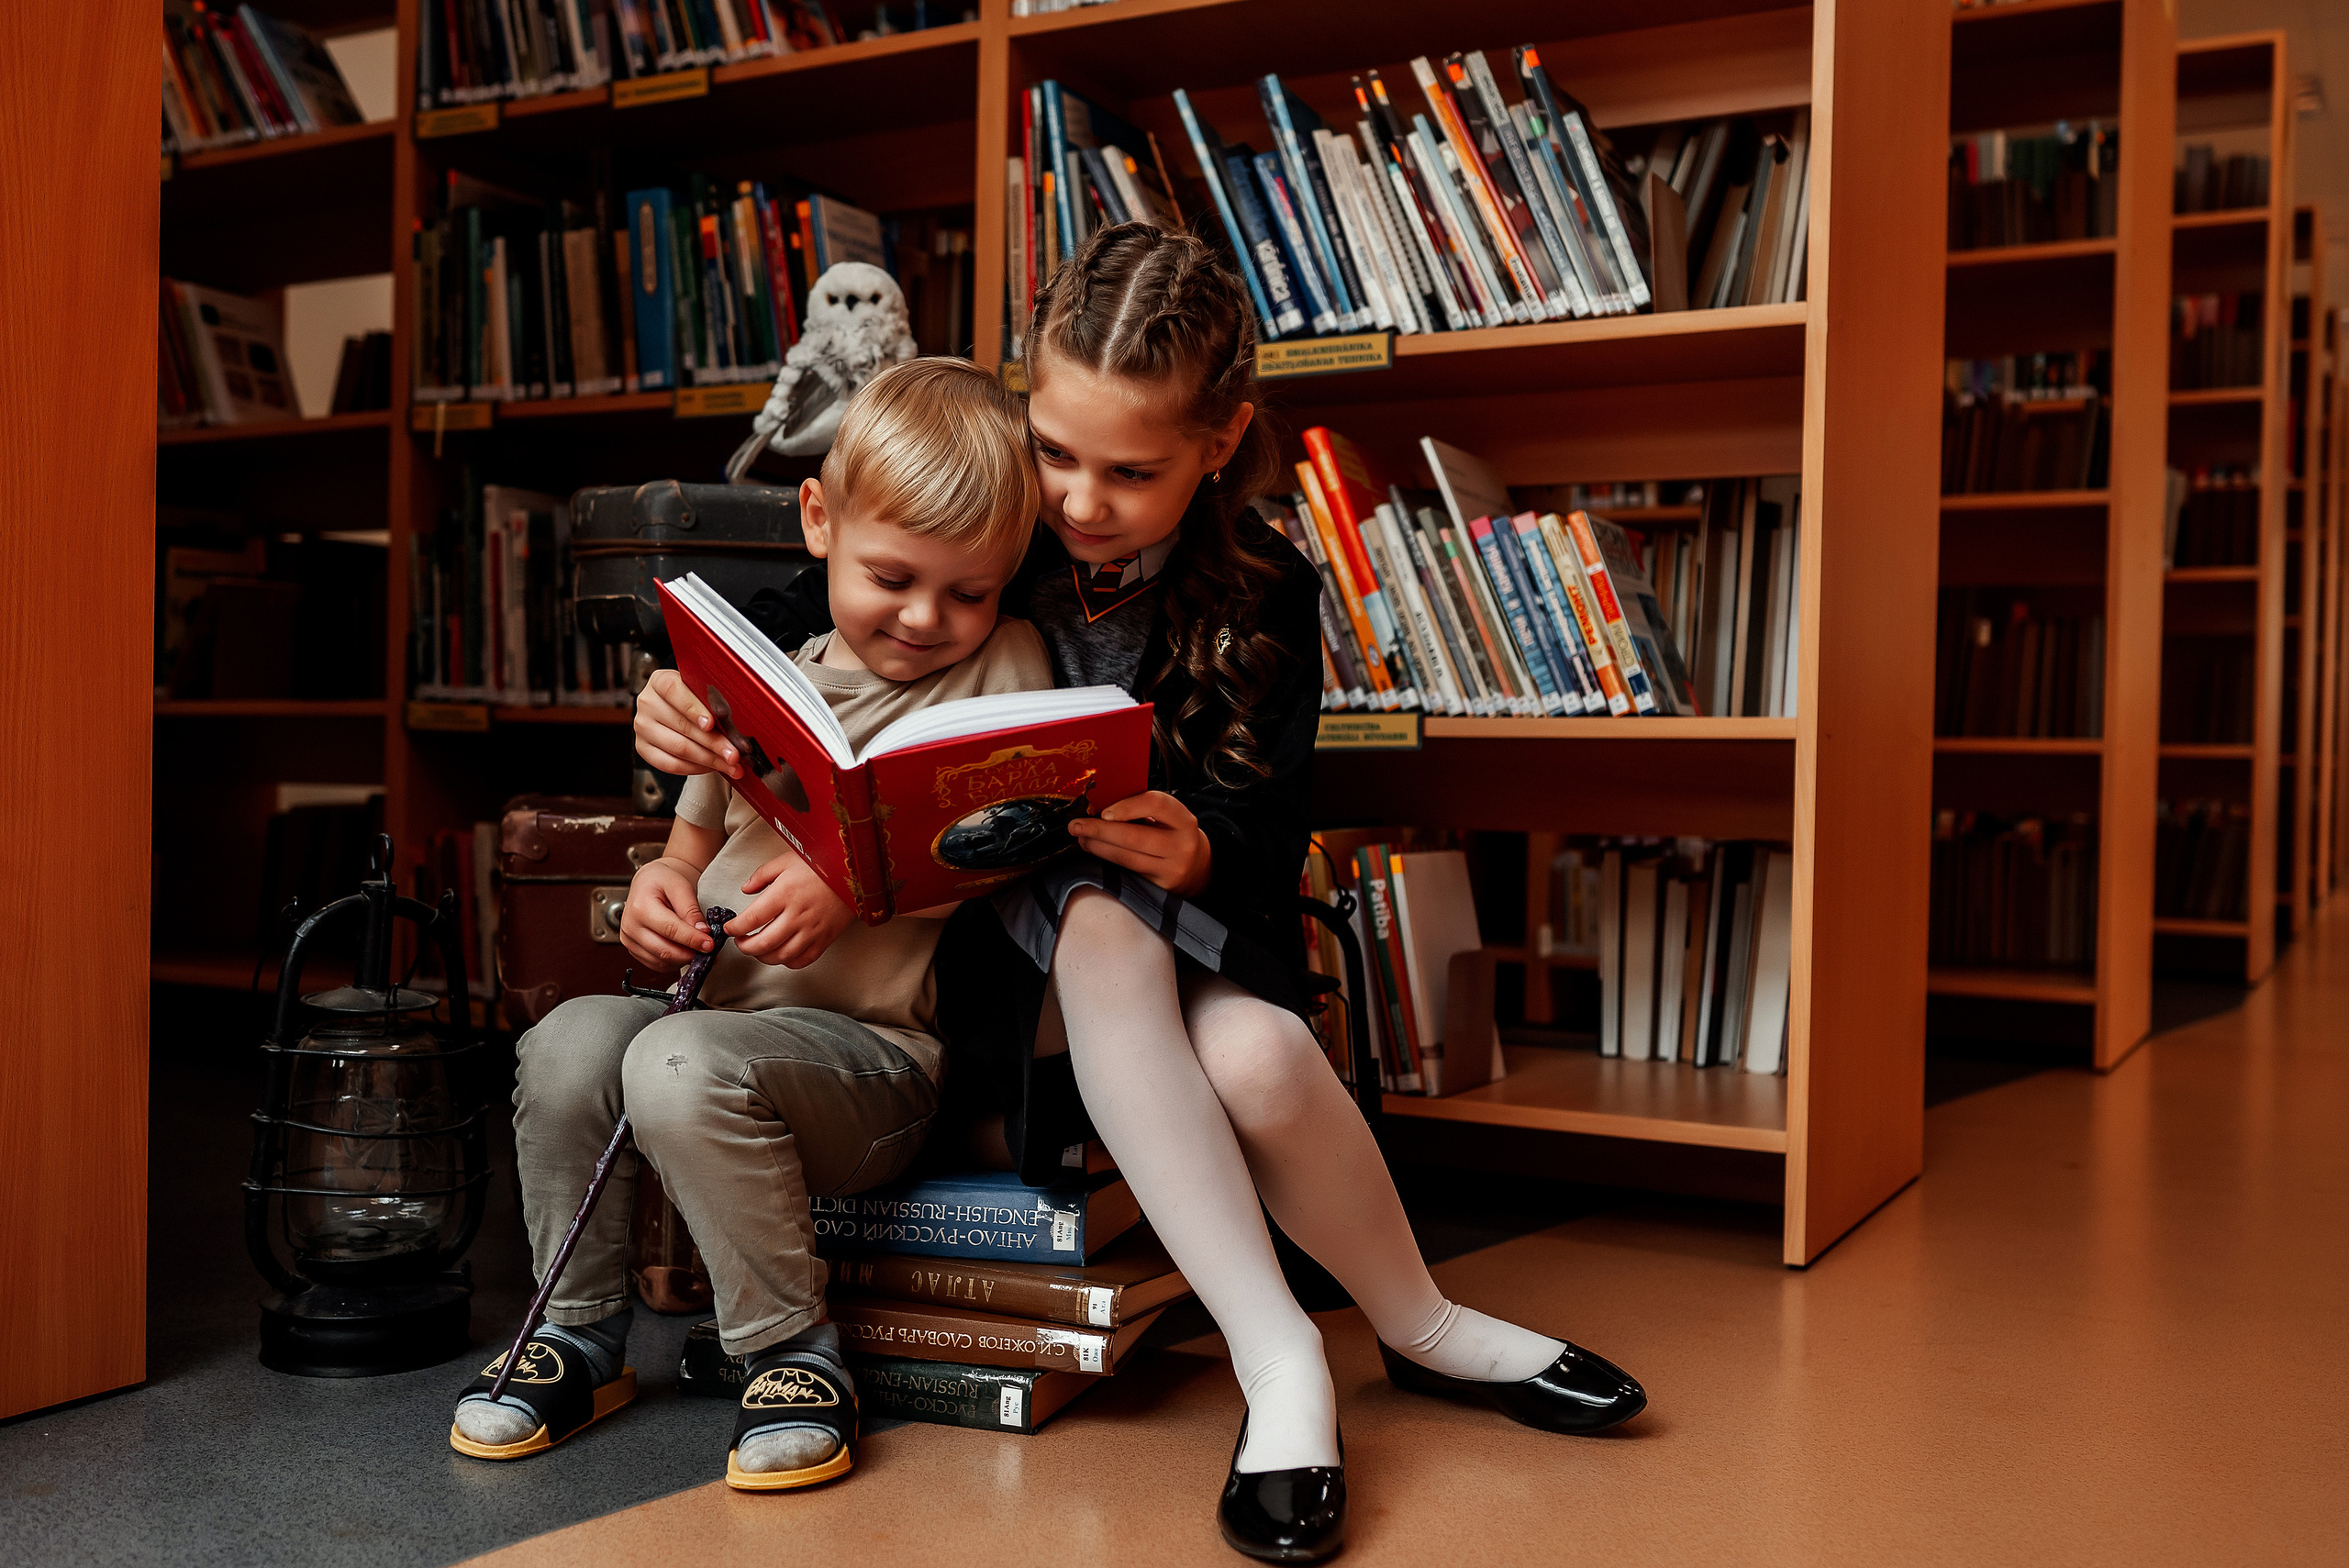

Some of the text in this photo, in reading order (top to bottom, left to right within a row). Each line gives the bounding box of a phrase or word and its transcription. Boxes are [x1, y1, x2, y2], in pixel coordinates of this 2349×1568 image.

[1566, 583, 1598, 645] РЕМОНТ
[966, 762, 1057, 791] БАРДА
[985, 758, 1043, 774] СКАЗКИ
[966, 775, 1061, 806] БИЛЛЯ
[863, 1199, 1038, 1227] ENGLISH-RUSSIAN
[814, 1218, 1037, 1249] АНГЛО-РУССКИЙ СЛО
[910, 1270, 996, 1303] АТЛАС
[898, 1328, 973, 1349] СЛОВАРЬ
[747, 1376, 814, 1396] BATMAN
